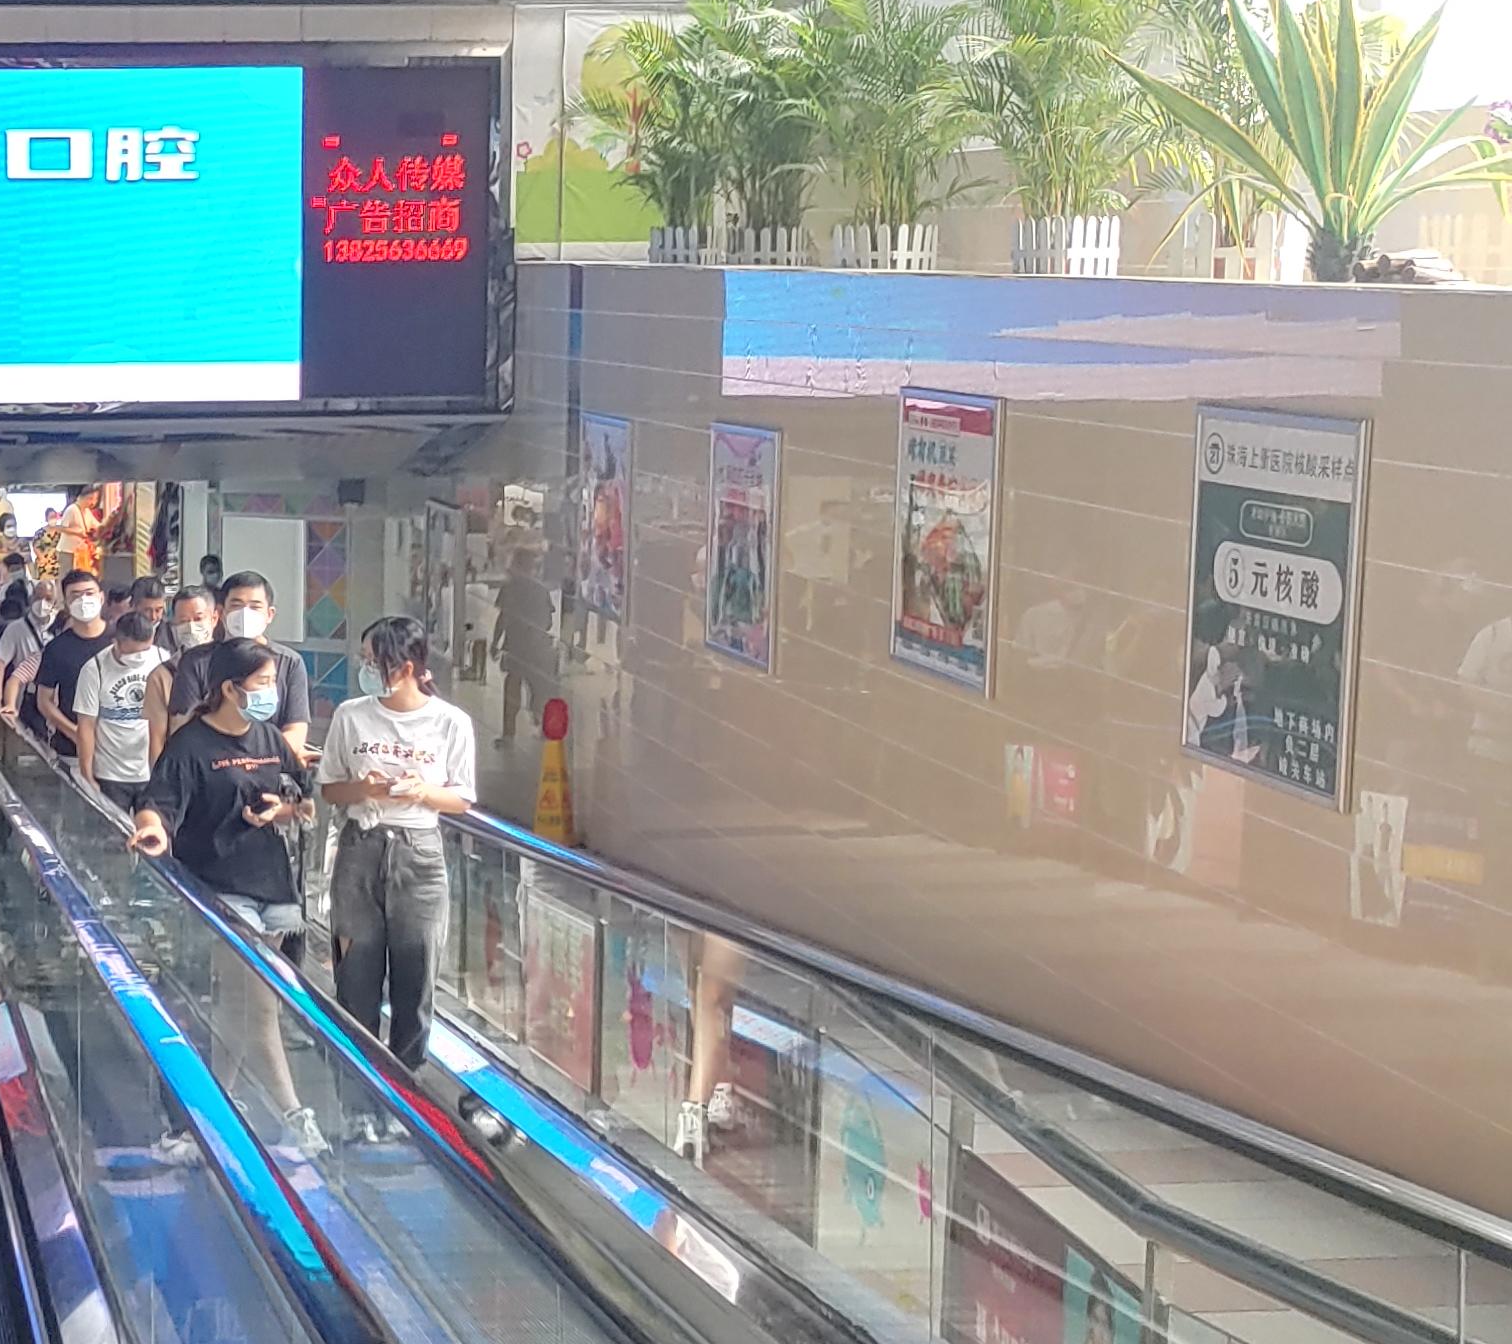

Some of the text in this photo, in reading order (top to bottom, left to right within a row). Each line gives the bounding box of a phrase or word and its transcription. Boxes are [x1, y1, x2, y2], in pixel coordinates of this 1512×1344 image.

[327, 154, 467, 193] 众人传媒
[324, 195, 462, 235] 广告招商
